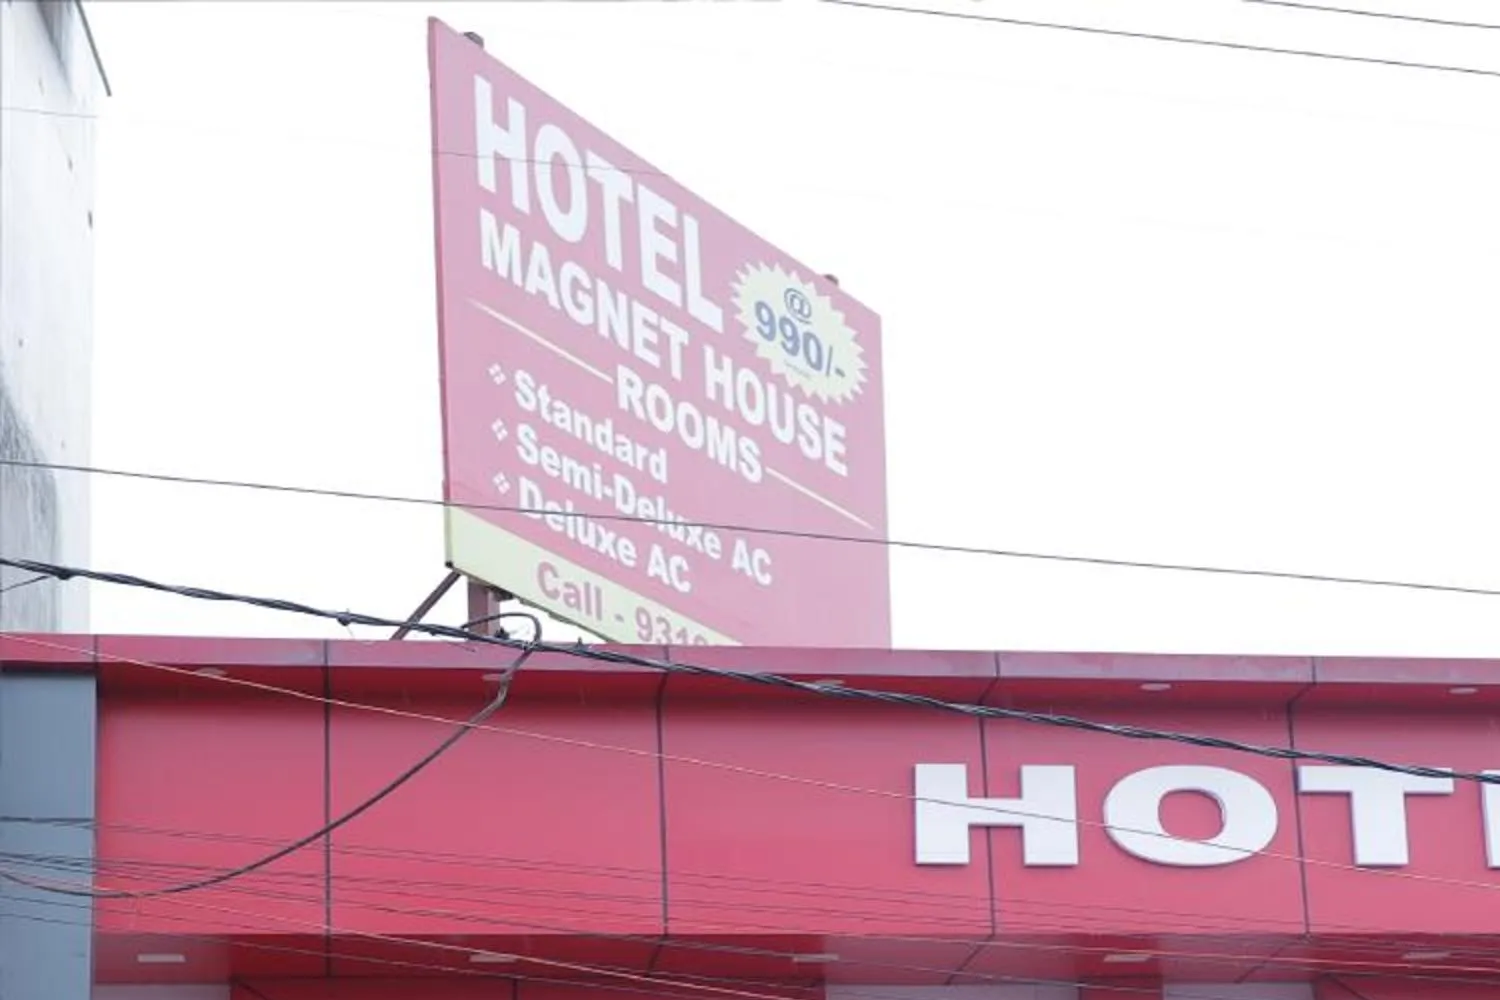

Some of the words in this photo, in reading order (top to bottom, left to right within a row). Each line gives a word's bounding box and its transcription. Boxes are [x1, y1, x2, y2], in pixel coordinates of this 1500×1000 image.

[474, 73, 724, 334] HOTEL
[480, 208, 690, 382] MAGNET
[704, 345, 848, 478] HOUSE
[755, 301, 846, 378] 990/-
[784, 288, 812, 324] @
[514, 369, 669, 484] Standard
[617, 365, 763, 484] ROOMS
[517, 423, 722, 560] Semi-Deluxe
[731, 539, 773, 586] AC
[518, 476, 638, 567] Deluxe
[647, 545, 692, 593] AC
[537, 561, 603, 621] Call
